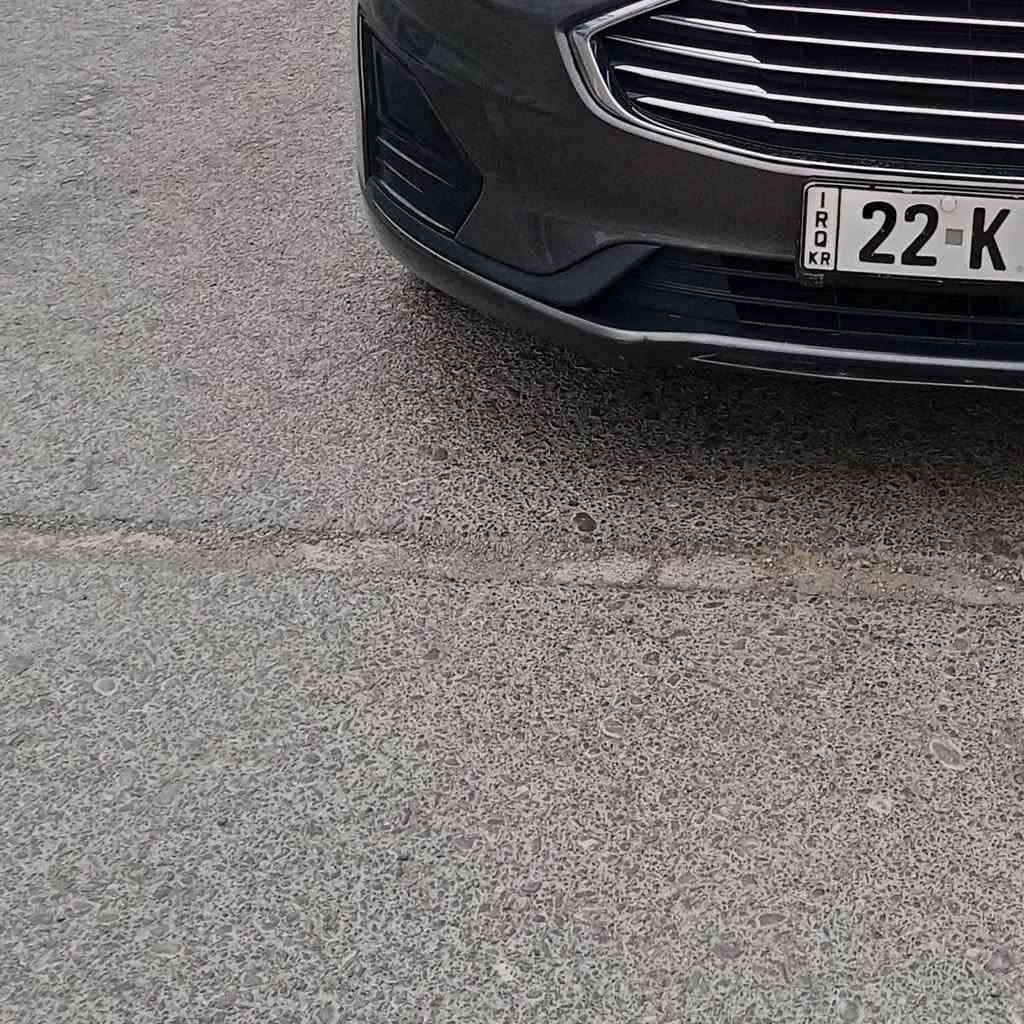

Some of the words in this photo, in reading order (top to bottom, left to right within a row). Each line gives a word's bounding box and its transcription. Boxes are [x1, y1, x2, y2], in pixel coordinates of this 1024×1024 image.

[858, 200, 940, 267] 22
[968, 207, 1011, 272] K
[808, 251, 831, 266] KR
